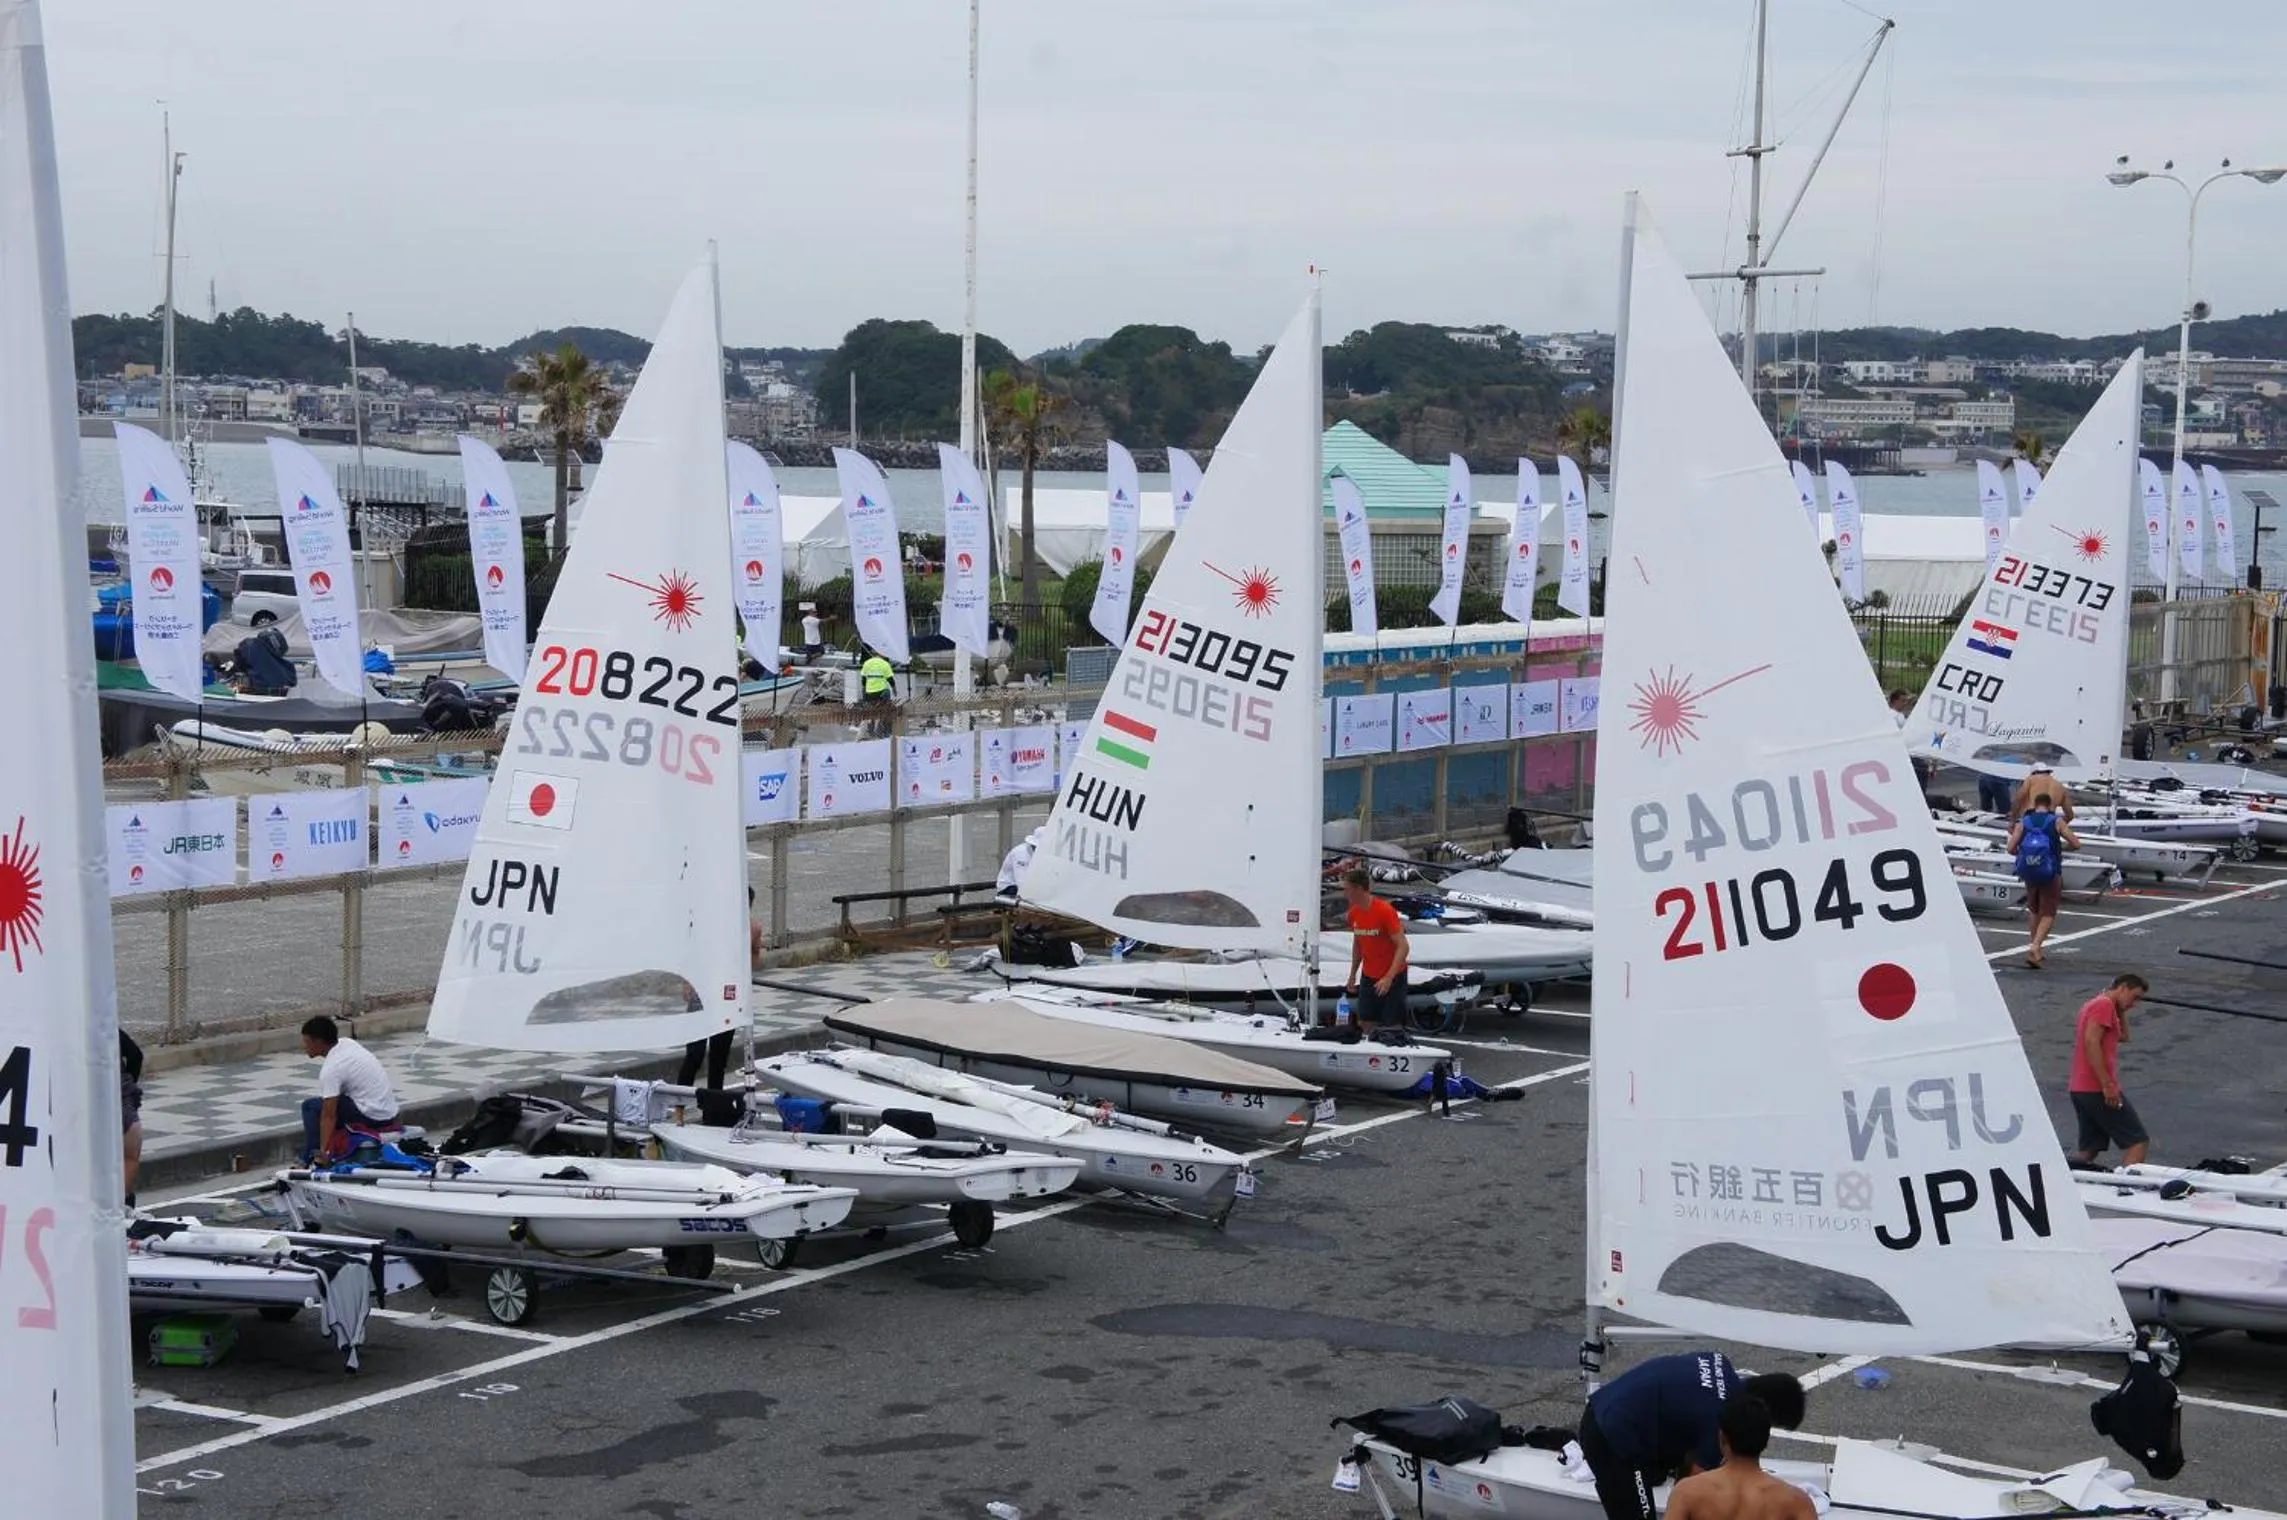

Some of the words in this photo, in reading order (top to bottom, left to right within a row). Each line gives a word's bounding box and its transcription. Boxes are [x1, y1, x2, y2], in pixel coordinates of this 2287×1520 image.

[1994, 556, 2115, 611] 213373
[1135, 609, 1295, 692] 213095
[536, 646, 738, 726] 208222
[1937, 664, 2004, 703] CRO
[759, 778, 781, 797] SAP
[848, 770, 884, 784] VOLVO
[1066, 771, 1146, 831] HUN
[163, 833, 225, 854] JR東日本
[309, 819, 356, 845] KEIKYU
[471, 859, 560, 916] JPN
[1992, 886, 2008, 899] 18
[1655, 848, 1928, 961] 211049
[1388, 1056, 1410, 1073] 32
[1242, 1094, 1265, 1109] 34
[1172, 1163, 1197, 1182] 36
[1874, 1163, 2051, 1251] JPN
[724, 1306, 781, 1323] 118
[1697, 1356, 1713, 1388] JAPAN
[1391, 1454, 1420, 1482] 39
